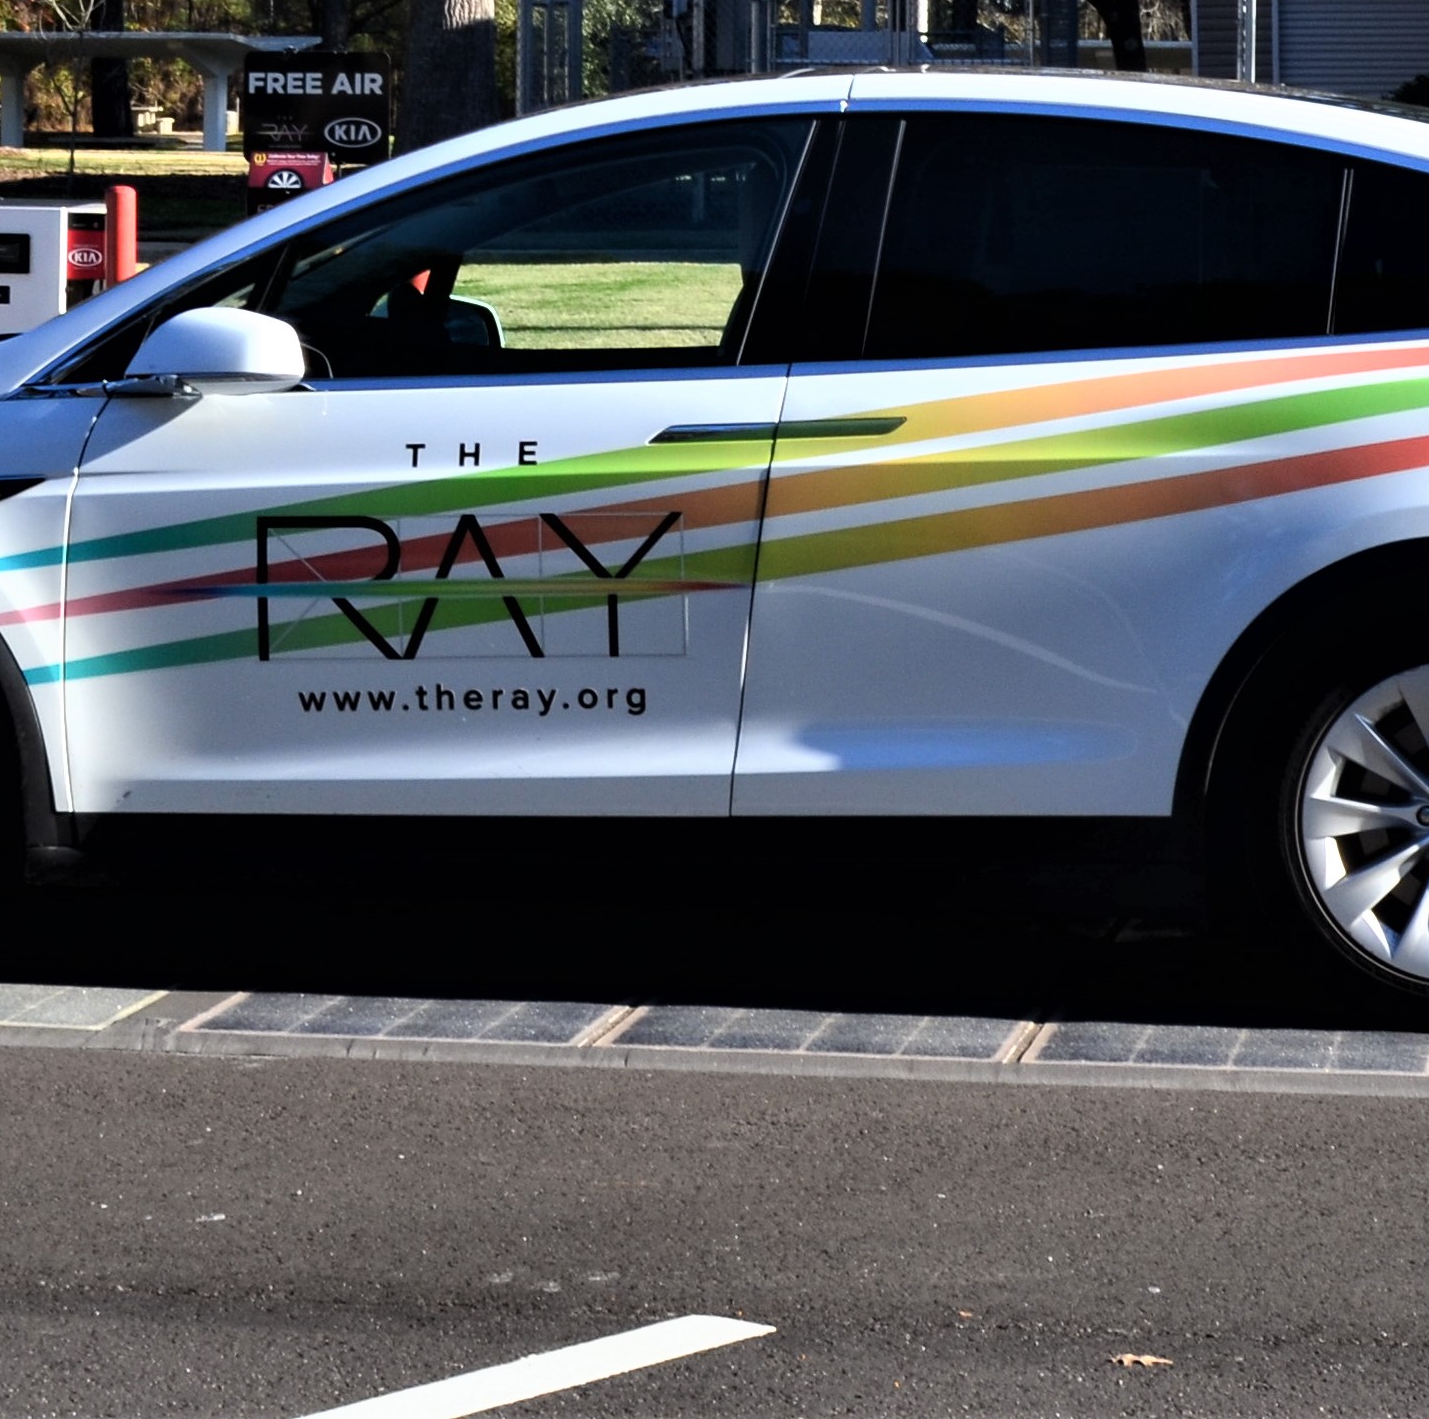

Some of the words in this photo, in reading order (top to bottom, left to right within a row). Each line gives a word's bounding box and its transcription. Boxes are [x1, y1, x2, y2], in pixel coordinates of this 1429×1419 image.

[248, 72, 323, 95] FREE
[332, 72, 383, 95] AIR
[261, 123, 308, 142] RAY
[334, 125, 373, 140] KIA
[405, 442, 538, 467] THE
[257, 512, 681, 661] RAY
[299, 684, 647, 715] www.theray.org
